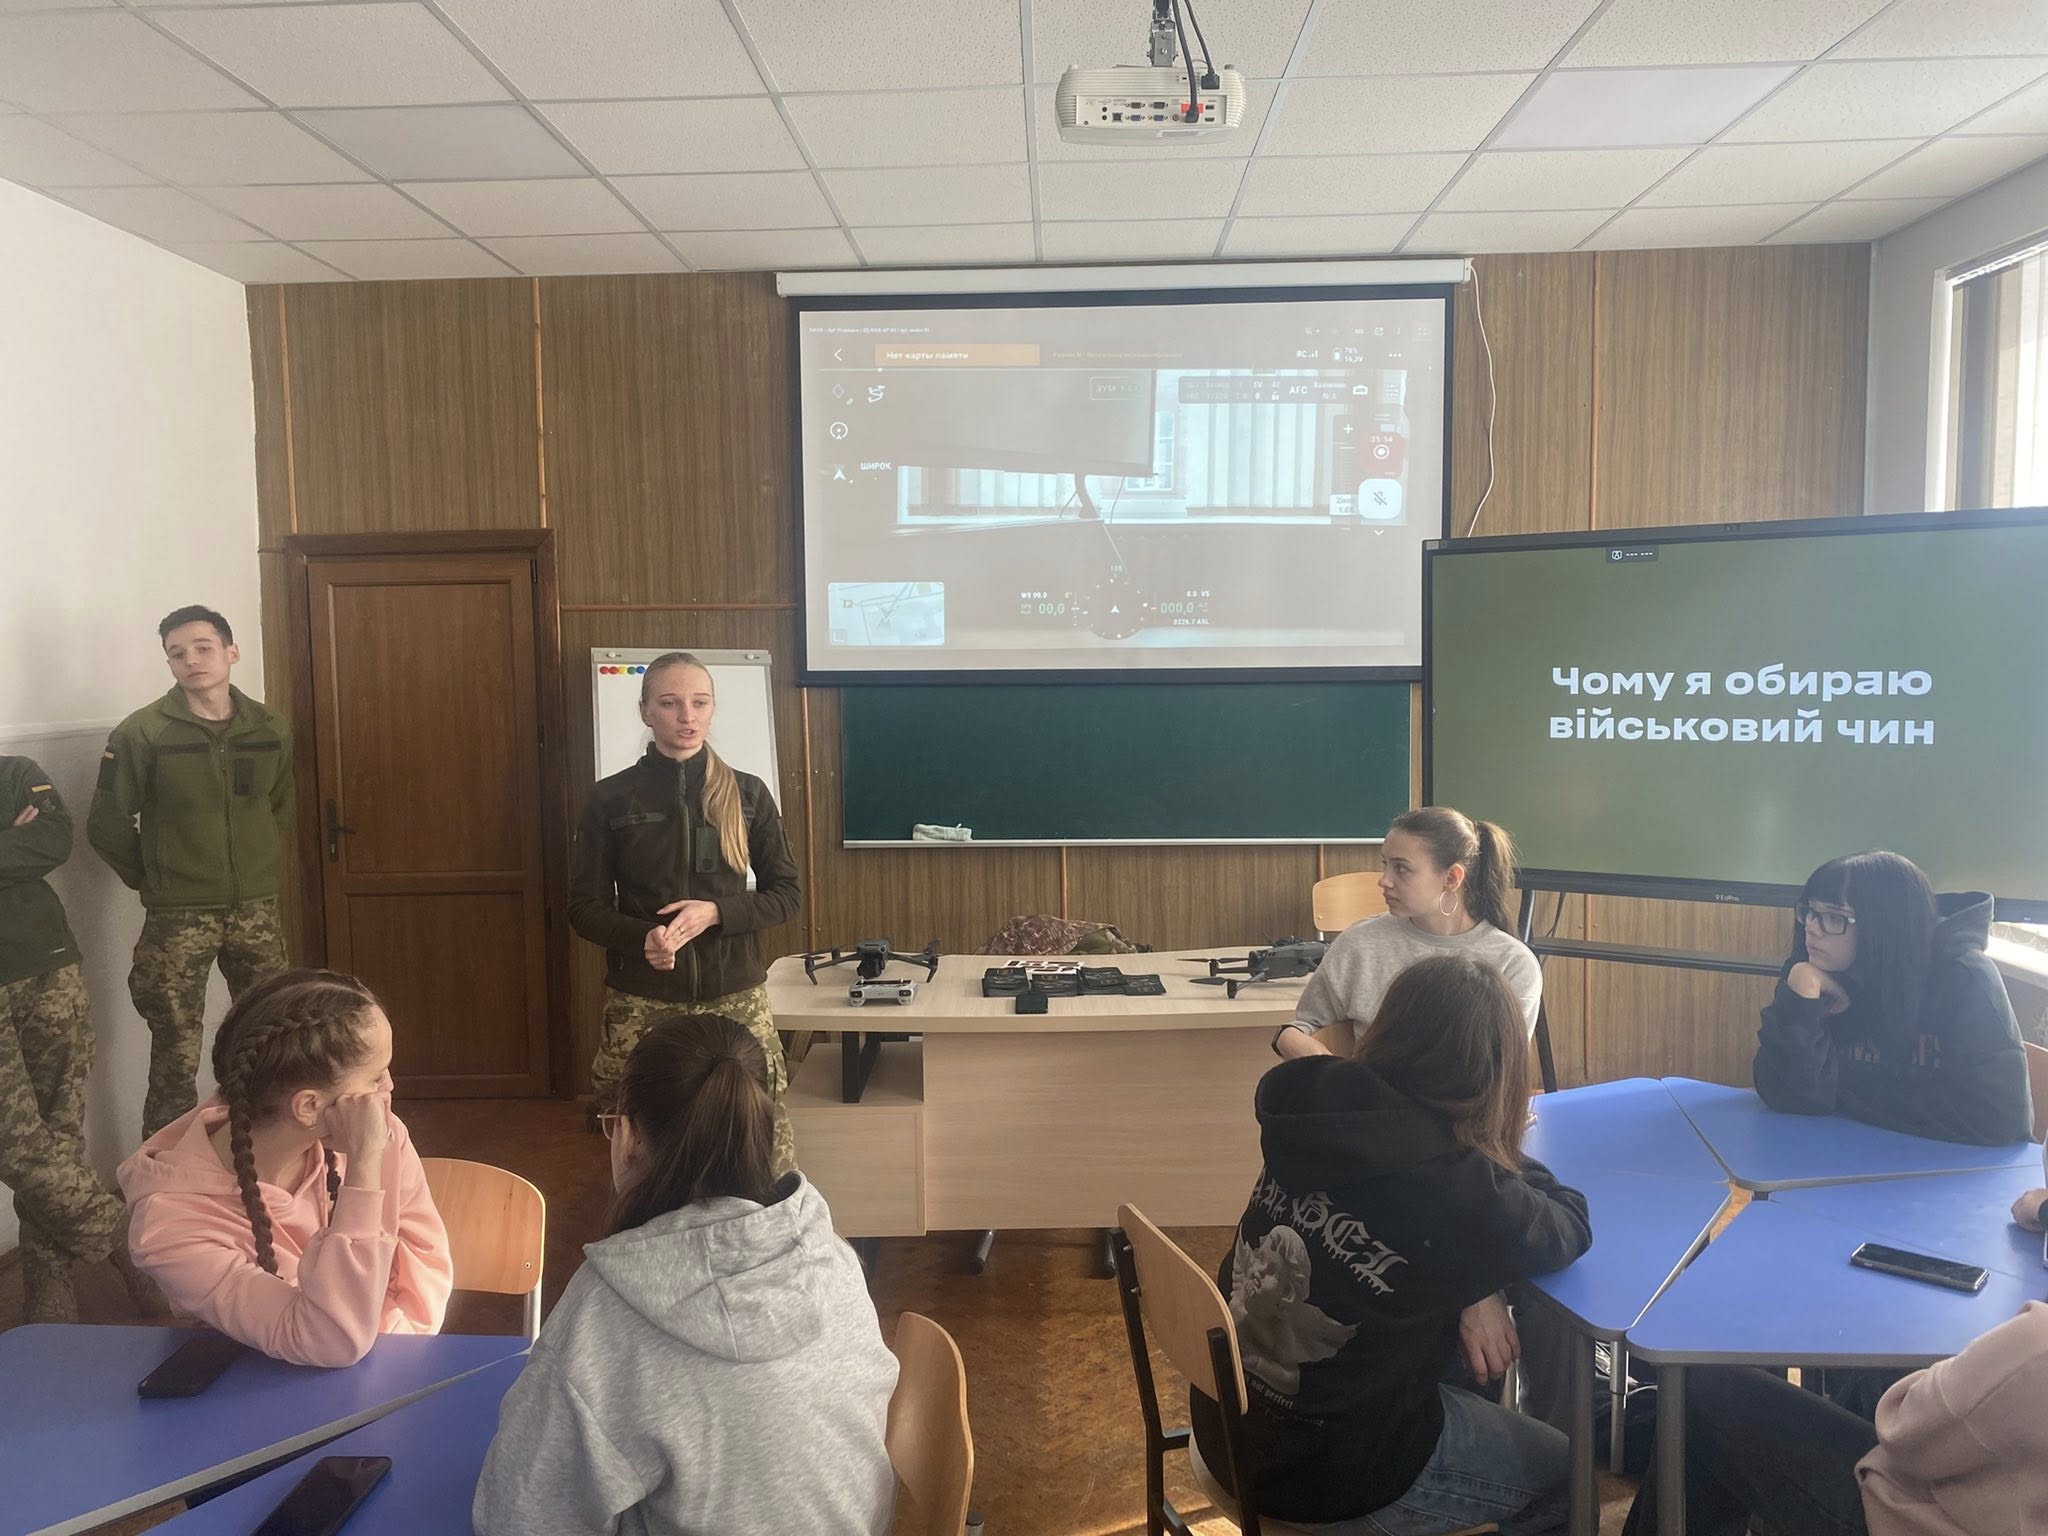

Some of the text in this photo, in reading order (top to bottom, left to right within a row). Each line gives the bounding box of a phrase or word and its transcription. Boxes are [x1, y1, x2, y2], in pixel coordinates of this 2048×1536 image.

[886, 352, 969, 361] Нет карты памяти
[1289, 385, 1308, 394] AFC
[860, 462, 892, 470] ШИРОК
[1552, 662, 1933, 702] Чому я обираю
[1549, 706, 1935, 745] військовий чин
